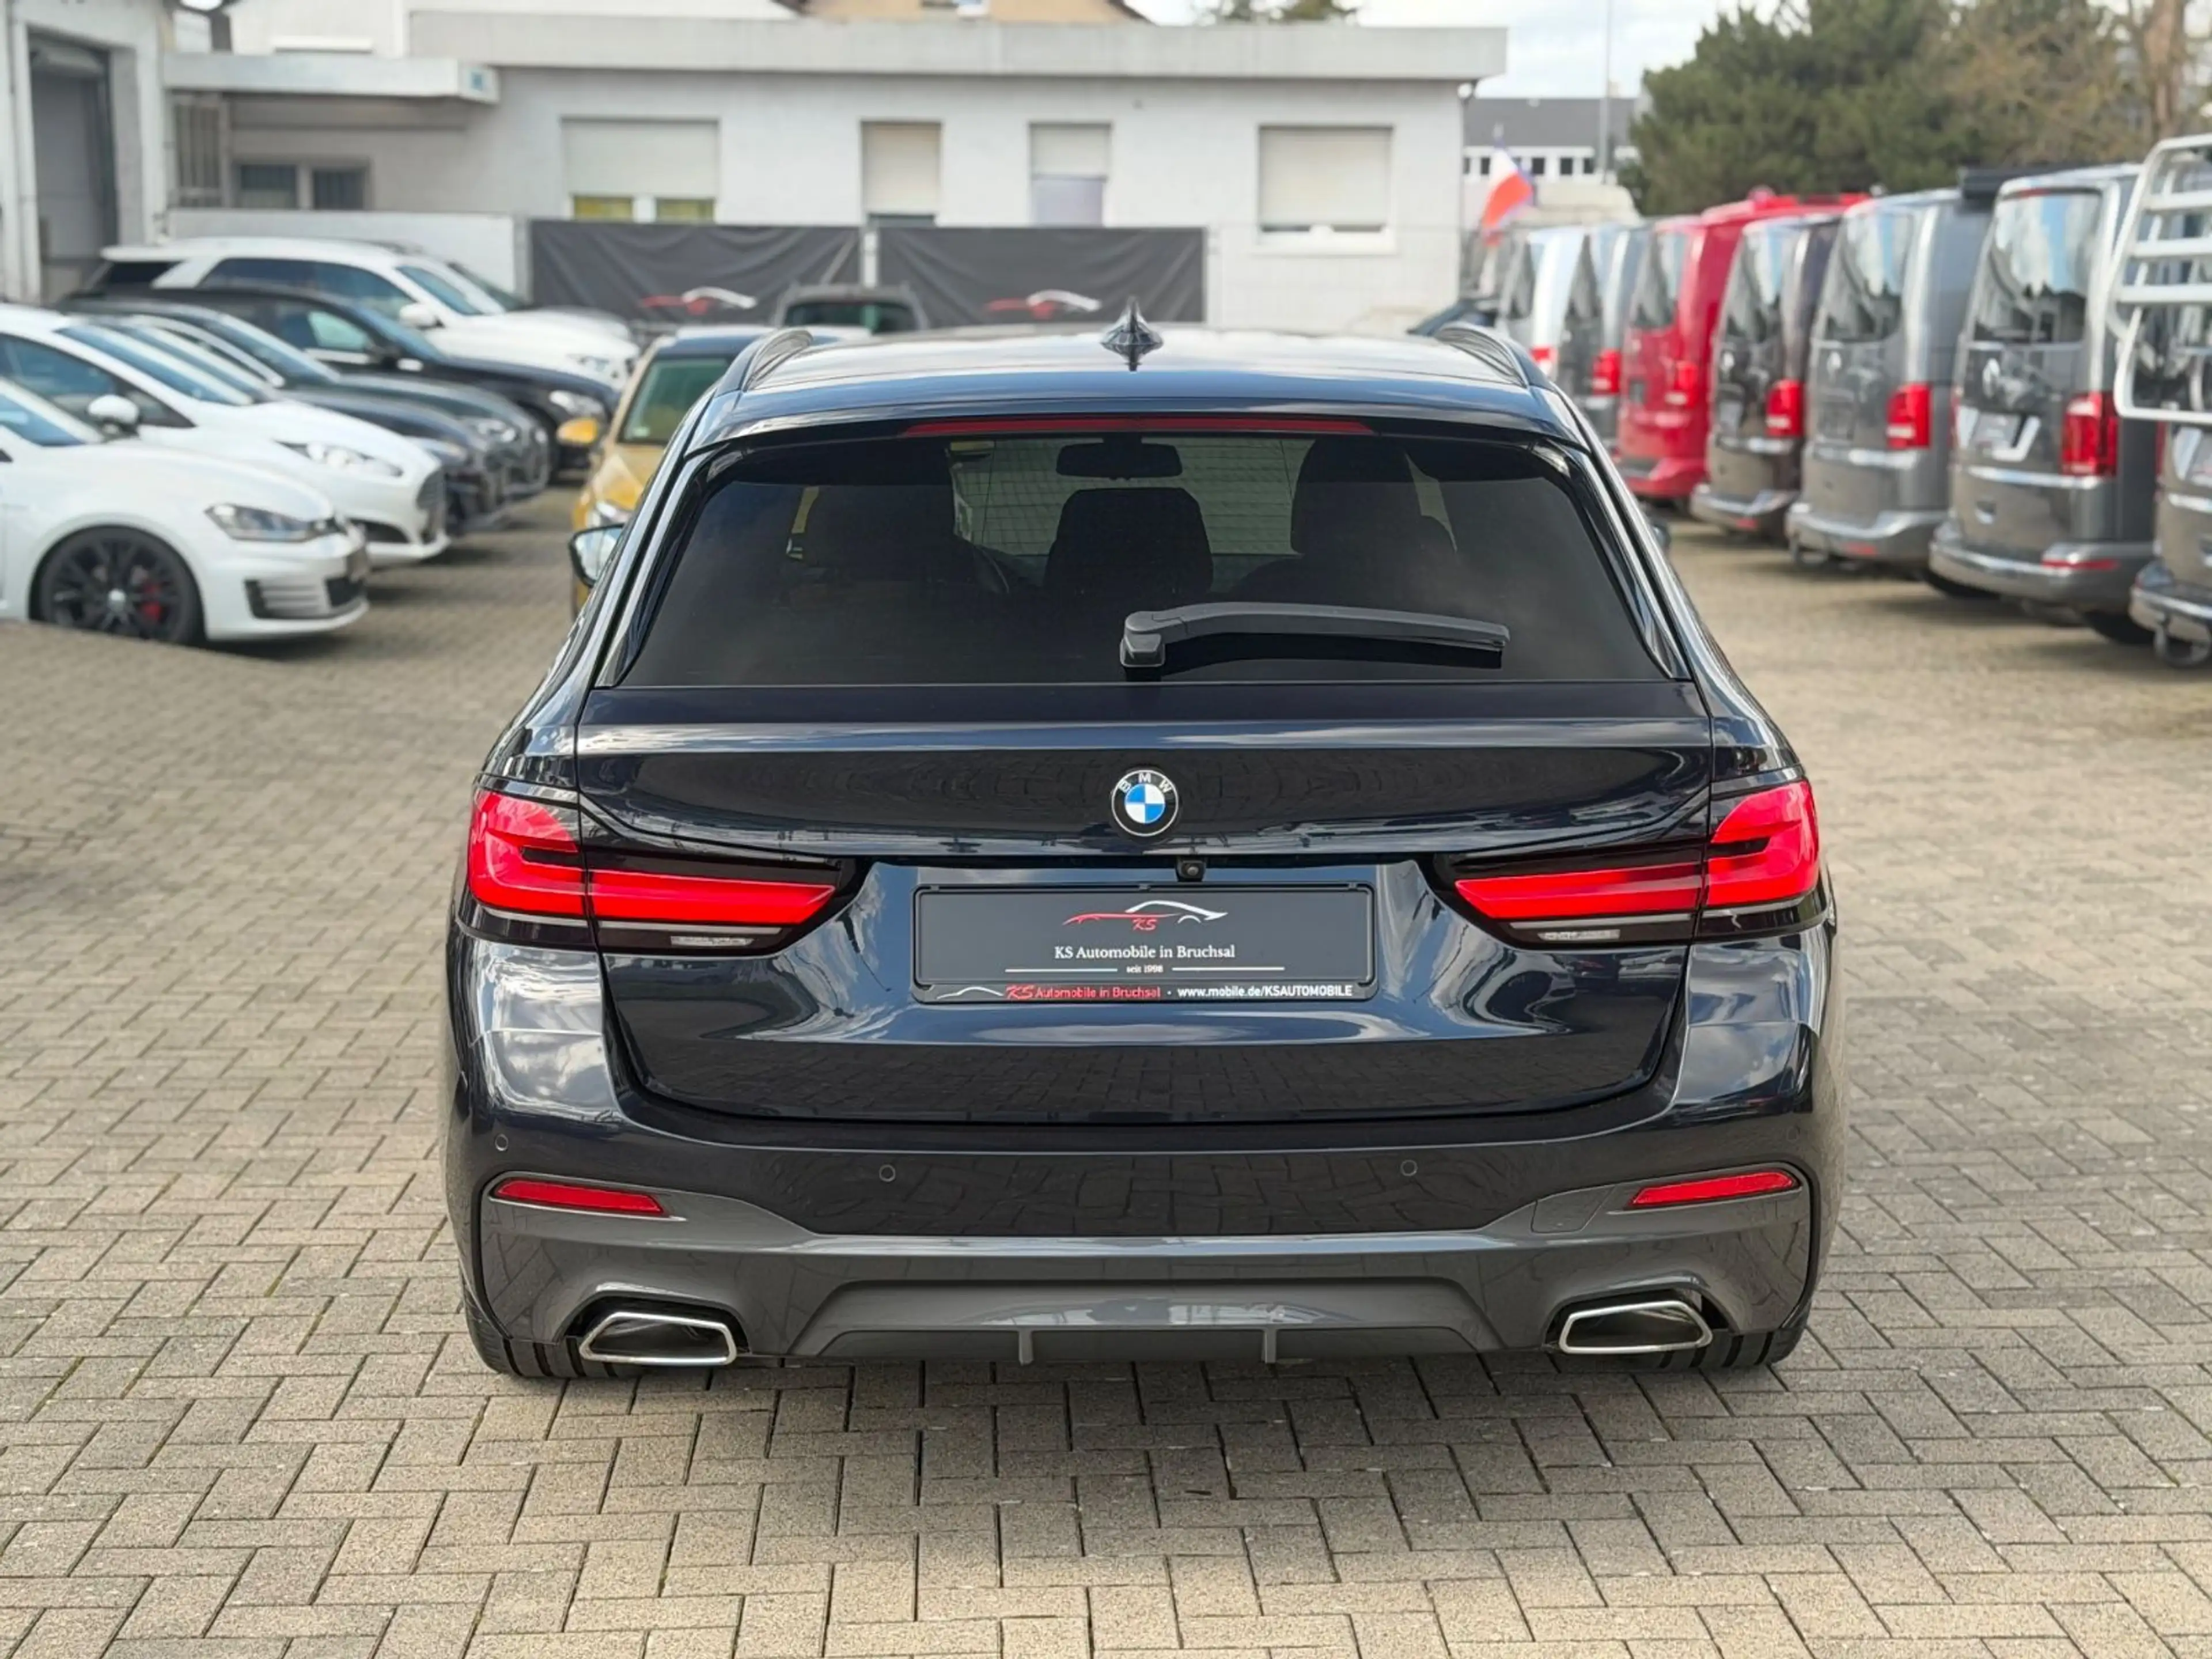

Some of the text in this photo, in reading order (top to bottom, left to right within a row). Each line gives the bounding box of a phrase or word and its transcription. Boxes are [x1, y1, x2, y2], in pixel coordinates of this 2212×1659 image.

[1118, 772, 1173, 793] BMW
[1132, 918, 1157, 931] KS
[1055, 945, 1236, 959] KS Automobile in Bruchsal
[1006, 984, 1353, 999] KS Automobile in Bruchsal www.mobile.de/KSAUTOMOBILE
